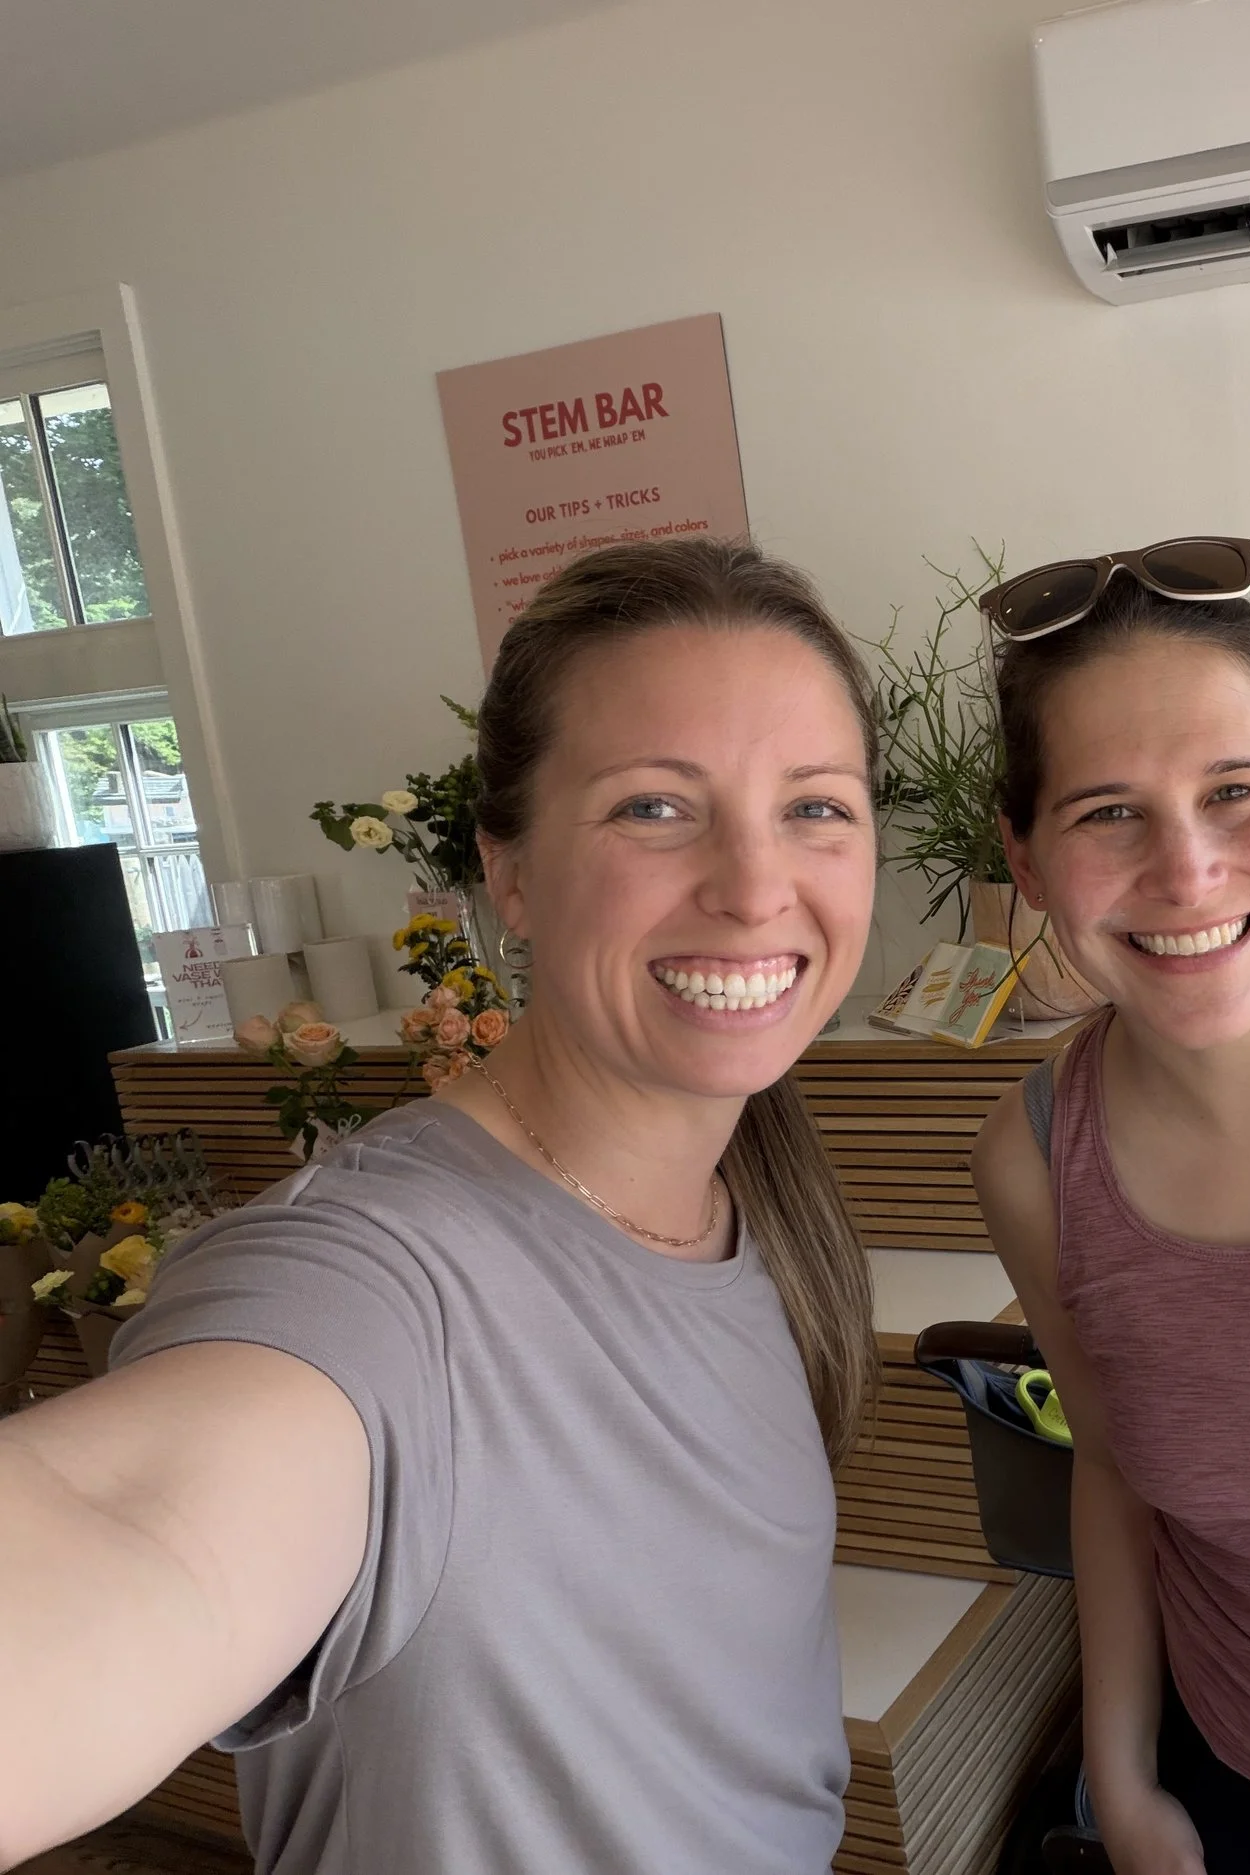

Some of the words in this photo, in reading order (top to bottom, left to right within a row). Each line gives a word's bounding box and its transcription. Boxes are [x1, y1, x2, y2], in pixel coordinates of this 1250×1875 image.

[502, 397, 589, 447] STEM
[595, 382, 670, 429] BAR
[529, 449, 546, 462] YOU
[547, 444, 568, 458] PICK
[589, 437, 602, 450] WE
[603, 432, 628, 448] WRAP
[525, 505, 556, 524] OUR
[559, 499, 590, 518] TIPS
[594, 501, 602, 511] +
[606, 487, 661, 510] TRICKS
[498, 547, 519, 565] pick
[520, 550, 528, 558] a
[529, 542, 565, 556] variety
[567, 536, 577, 549] of
[651, 521, 673, 536] and
[675, 518, 709, 534] colors
[502, 576, 518, 587] we
[519, 571, 541, 585] love
[172, 970, 211, 982] VASE
